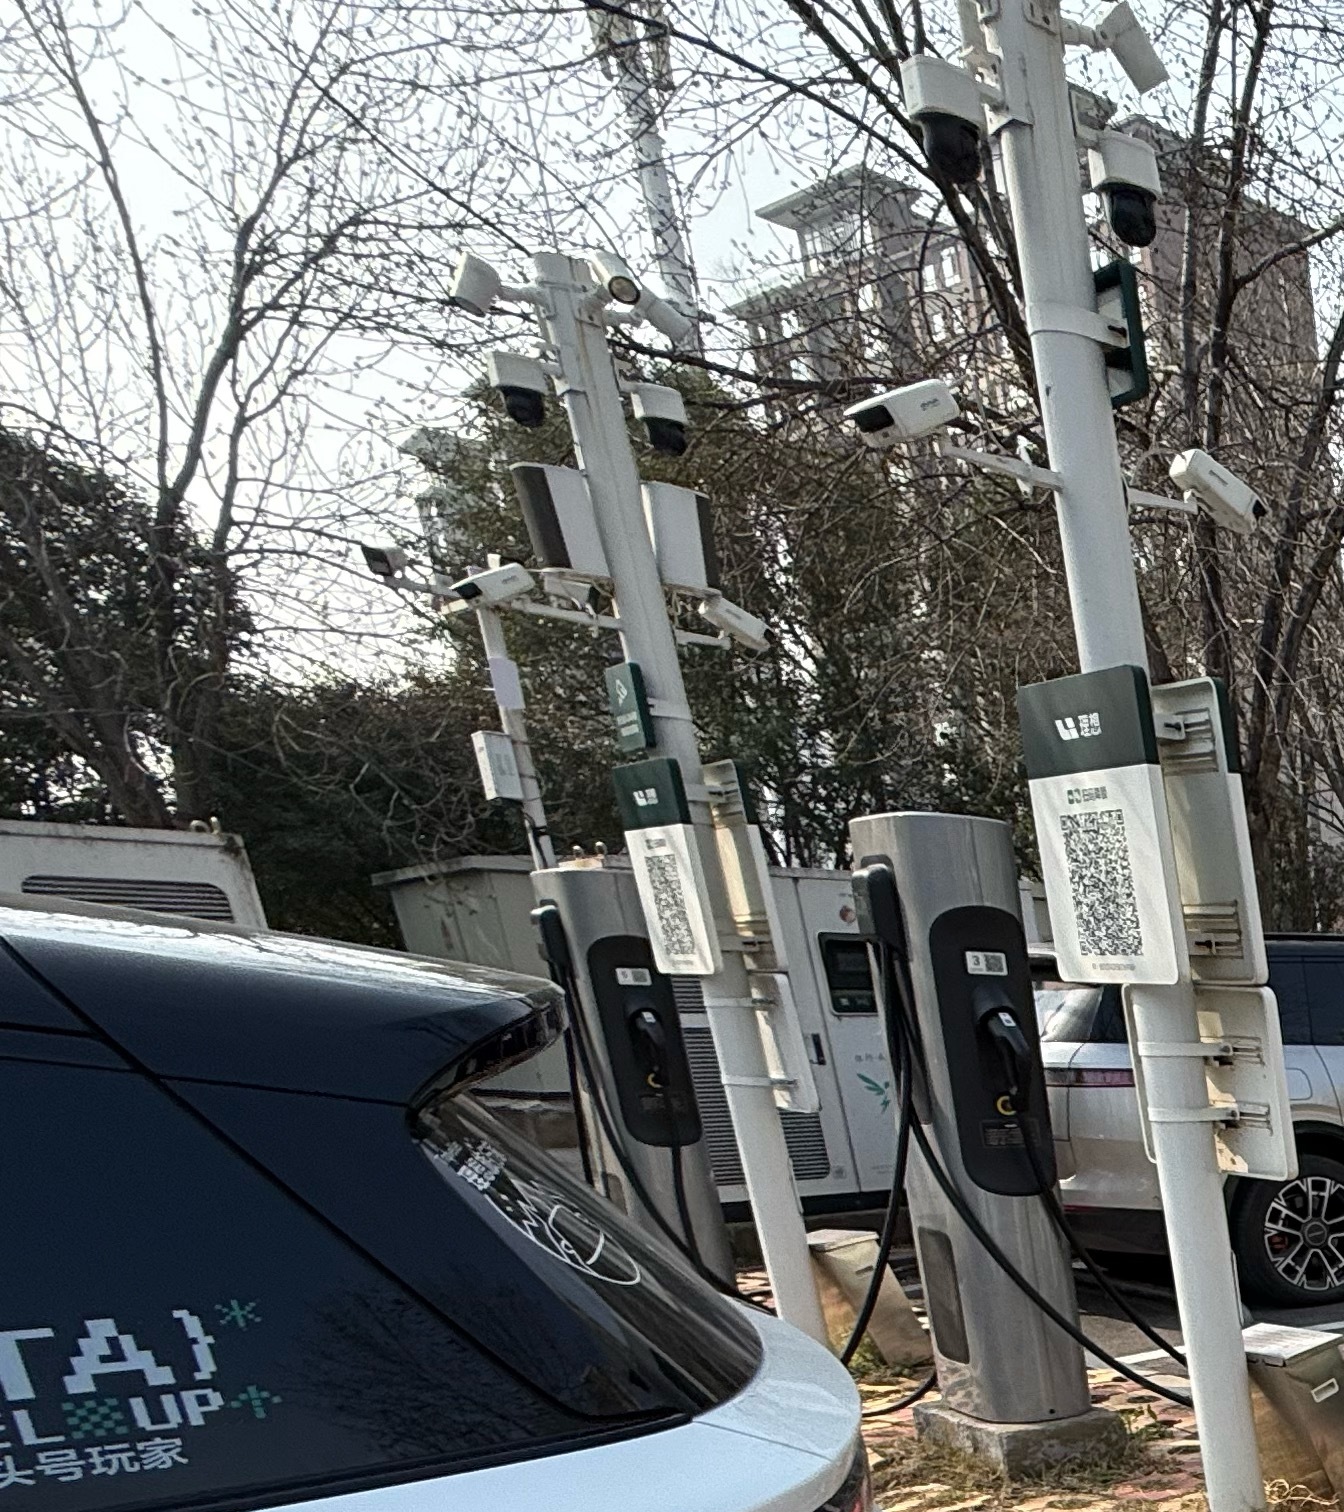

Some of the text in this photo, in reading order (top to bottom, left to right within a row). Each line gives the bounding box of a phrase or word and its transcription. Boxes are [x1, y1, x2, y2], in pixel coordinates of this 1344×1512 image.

[129, 1388, 224, 1431] UP
[0, 1437, 189, 1488] 头号玩家
